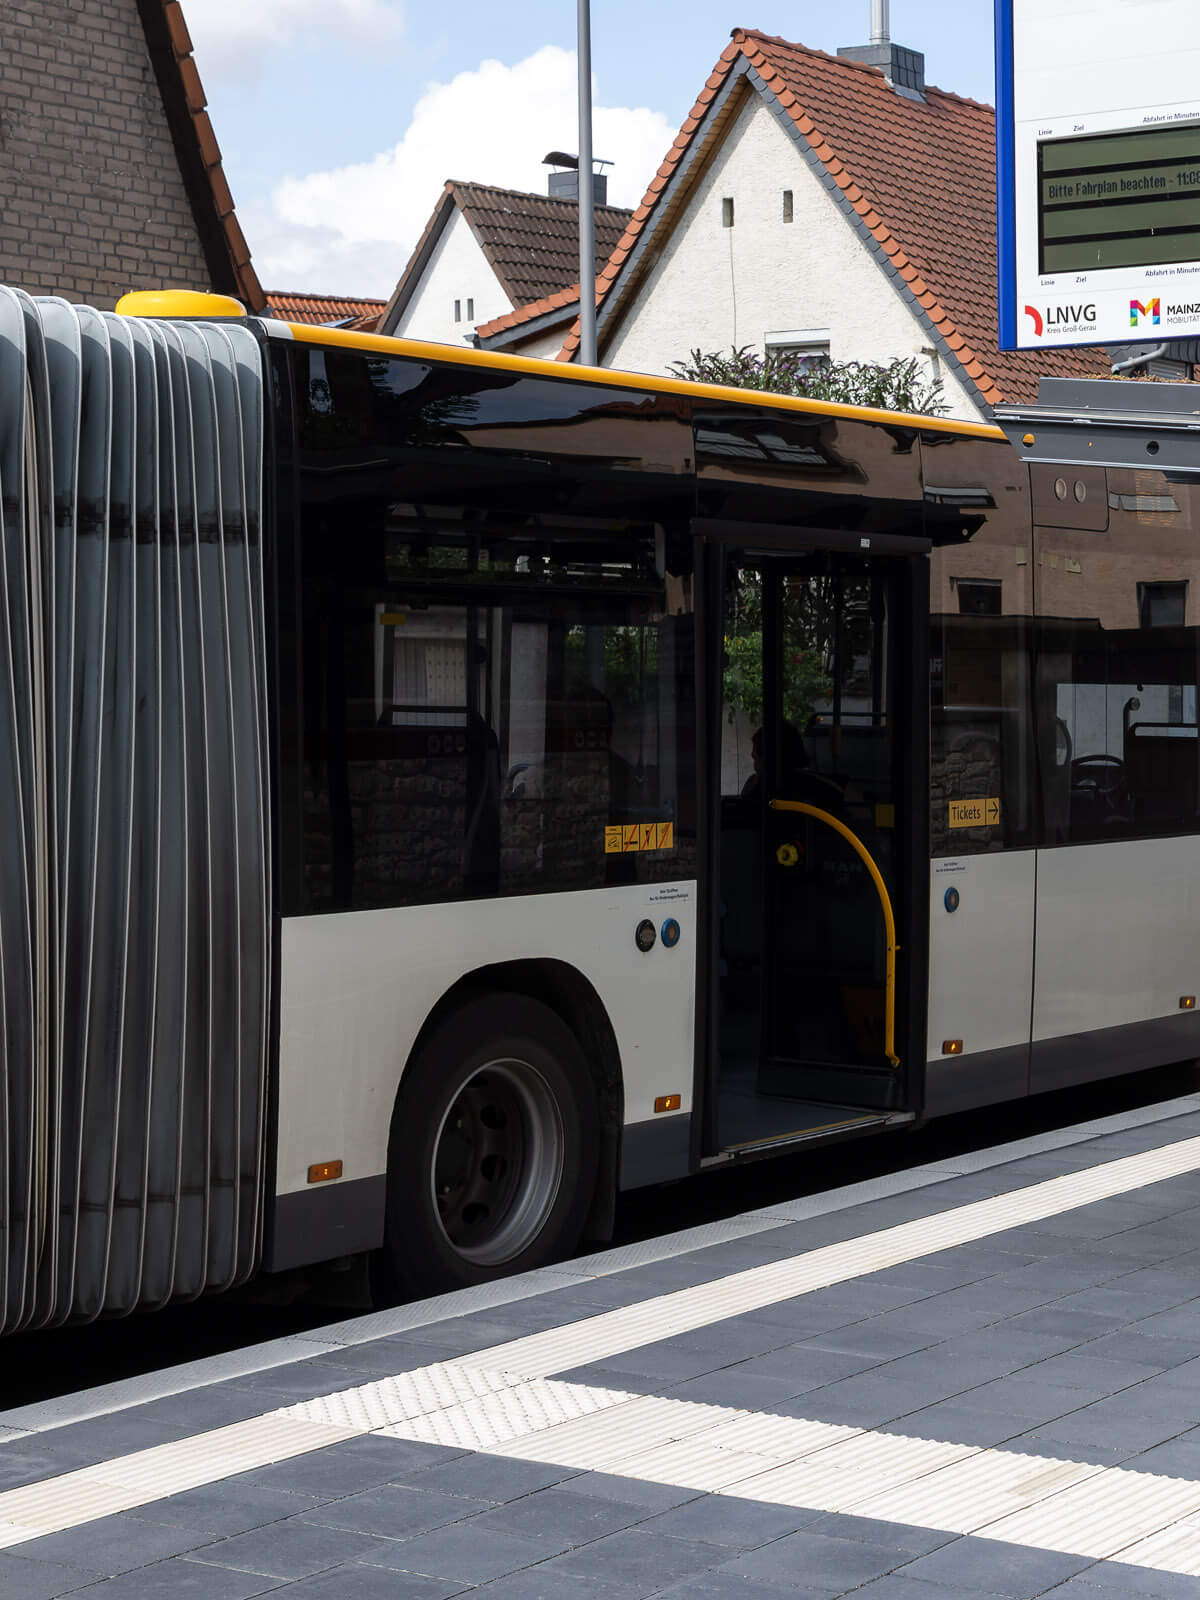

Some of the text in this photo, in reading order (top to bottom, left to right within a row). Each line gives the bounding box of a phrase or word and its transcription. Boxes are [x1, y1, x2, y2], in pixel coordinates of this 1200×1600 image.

[1174, 112, 1200, 120] Minuten
[1038, 128, 1053, 136] Linie
[1048, 183, 1073, 199] Bitte
[1075, 179, 1118, 198] Fahrplan
[1120, 174, 1166, 192] beachten
[1145, 269, 1168, 277] Abfahrt
[1046, 303, 1097, 325] LNVG
[1166, 314, 1200, 325] MOBILITÄT
[1046, 323, 1097, 334] Kreis Groß-Gerau
[951, 805, 981, 820] Tickets
